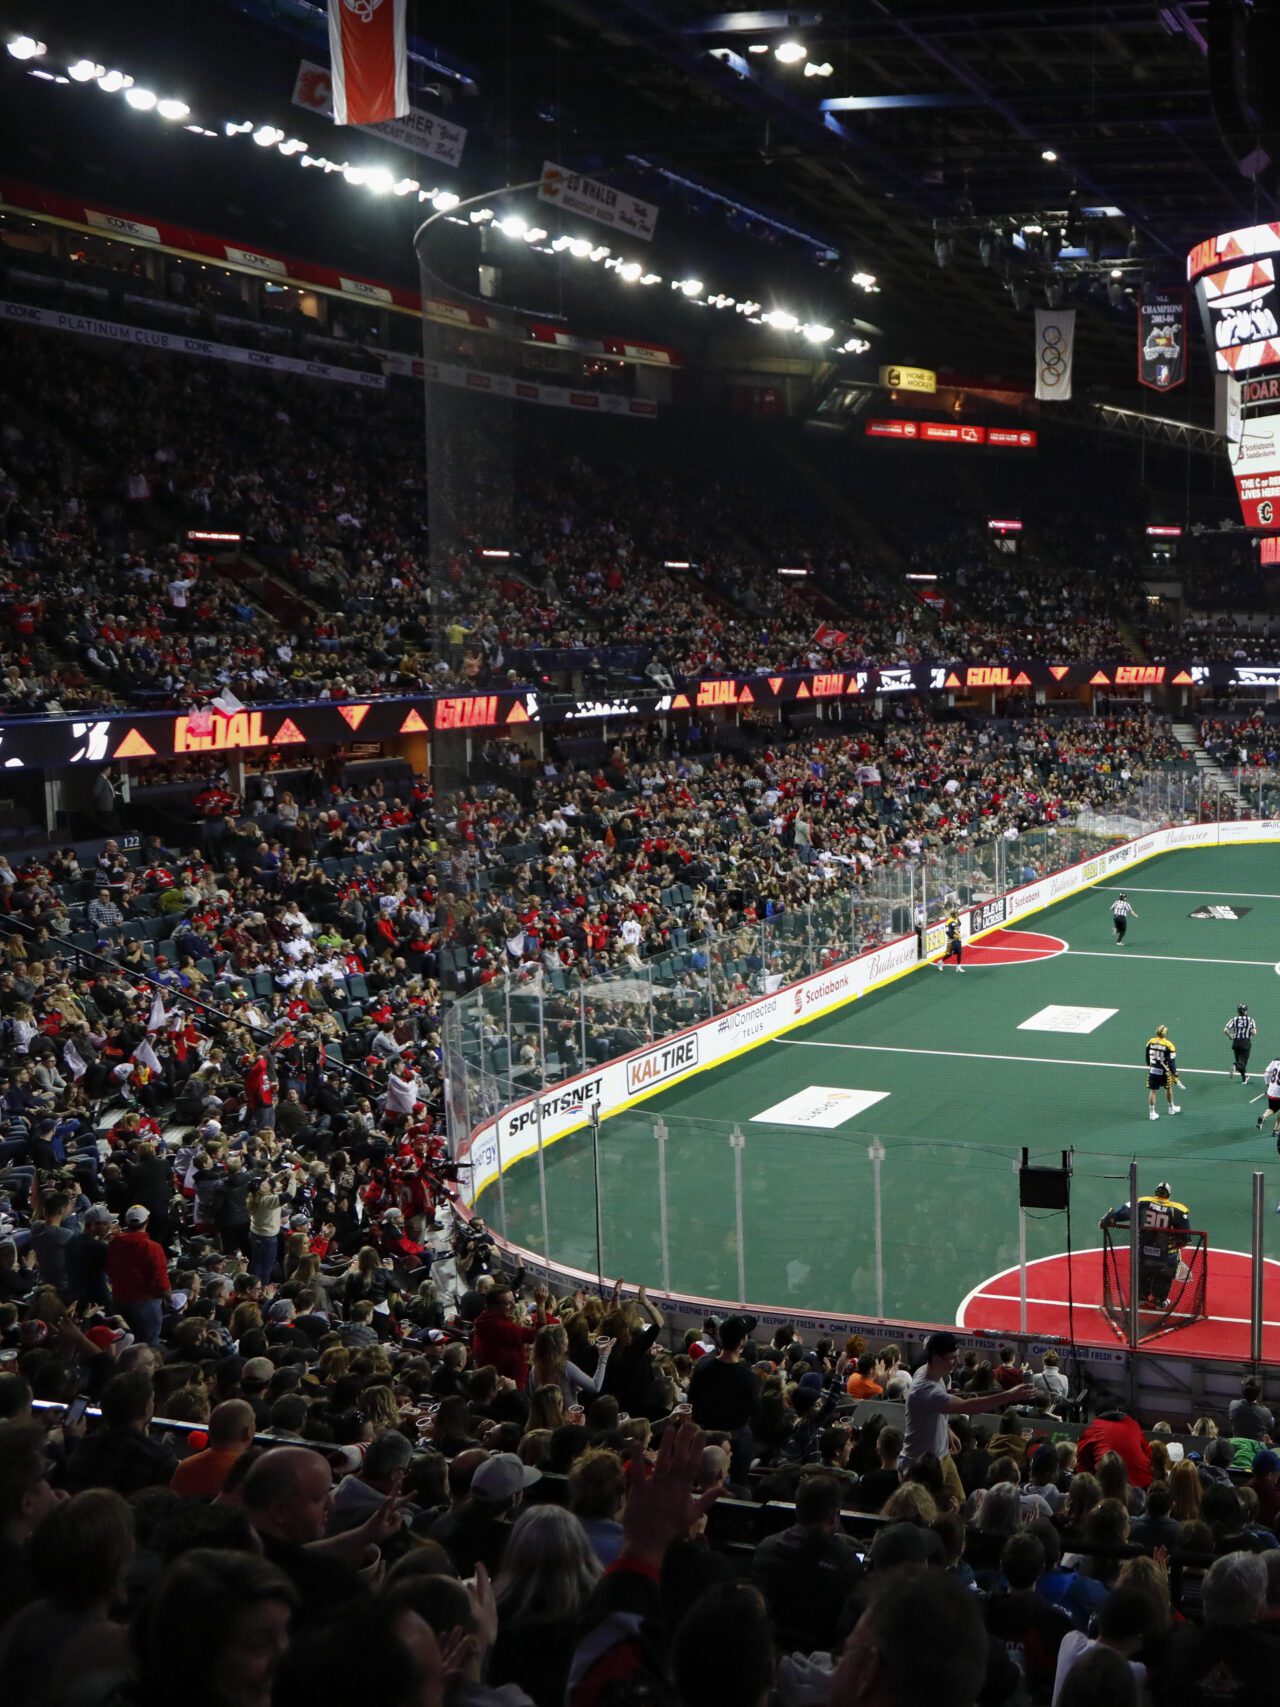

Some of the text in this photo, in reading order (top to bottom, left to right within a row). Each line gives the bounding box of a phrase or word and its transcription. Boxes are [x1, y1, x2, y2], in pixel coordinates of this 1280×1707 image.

[1141, 303, 1183, 314] CHAMPIONS
[59, 315, 130, 342] PLATINUM
[135, 330, 169, 347] CLUB
[1245, 442, 1275, 452] Scotiabank
[1240, 478, 1254, 489] THE
[1241, 486, 1280, 499] LIVES HERE
[966, 667, 1013, 687] GOAL
[1115, 666, 1166, 684] GOAL
[696, 680, 738, 707] GOAL
[812, 673, 844, 696] GOAL
[434, 695, 498, 729] GOAL
[174, 711, 269, 753] GOAL
[1165, 830, 1208, 846] Budweiser
[1014, 890, 1040, 909] Scotiabank
[866, 948, 915, 981] Budweiser
[805, 975, 849, 1004] Scotiabank
[718, 1000, 777, 1034] #AllConnected
[1238, 1019, 1248, 1028] 21
[742, 1023, 764, 1038] TELUS
[509, 1078, 603, 1137] SPORTSNET
[1144, 1209, 1169, 1229] 30
[678, 1306, 702, 1316] KEEPING
[796, 1319, 816, 1330] FRESH
[850, 1325, 876, 1337] KEEPING
[884, 1329, 904, 1340] FRESH
[975, 1339, 996, 1349] FRESH
[1090, 1351, 1112, 1361] FRESH
